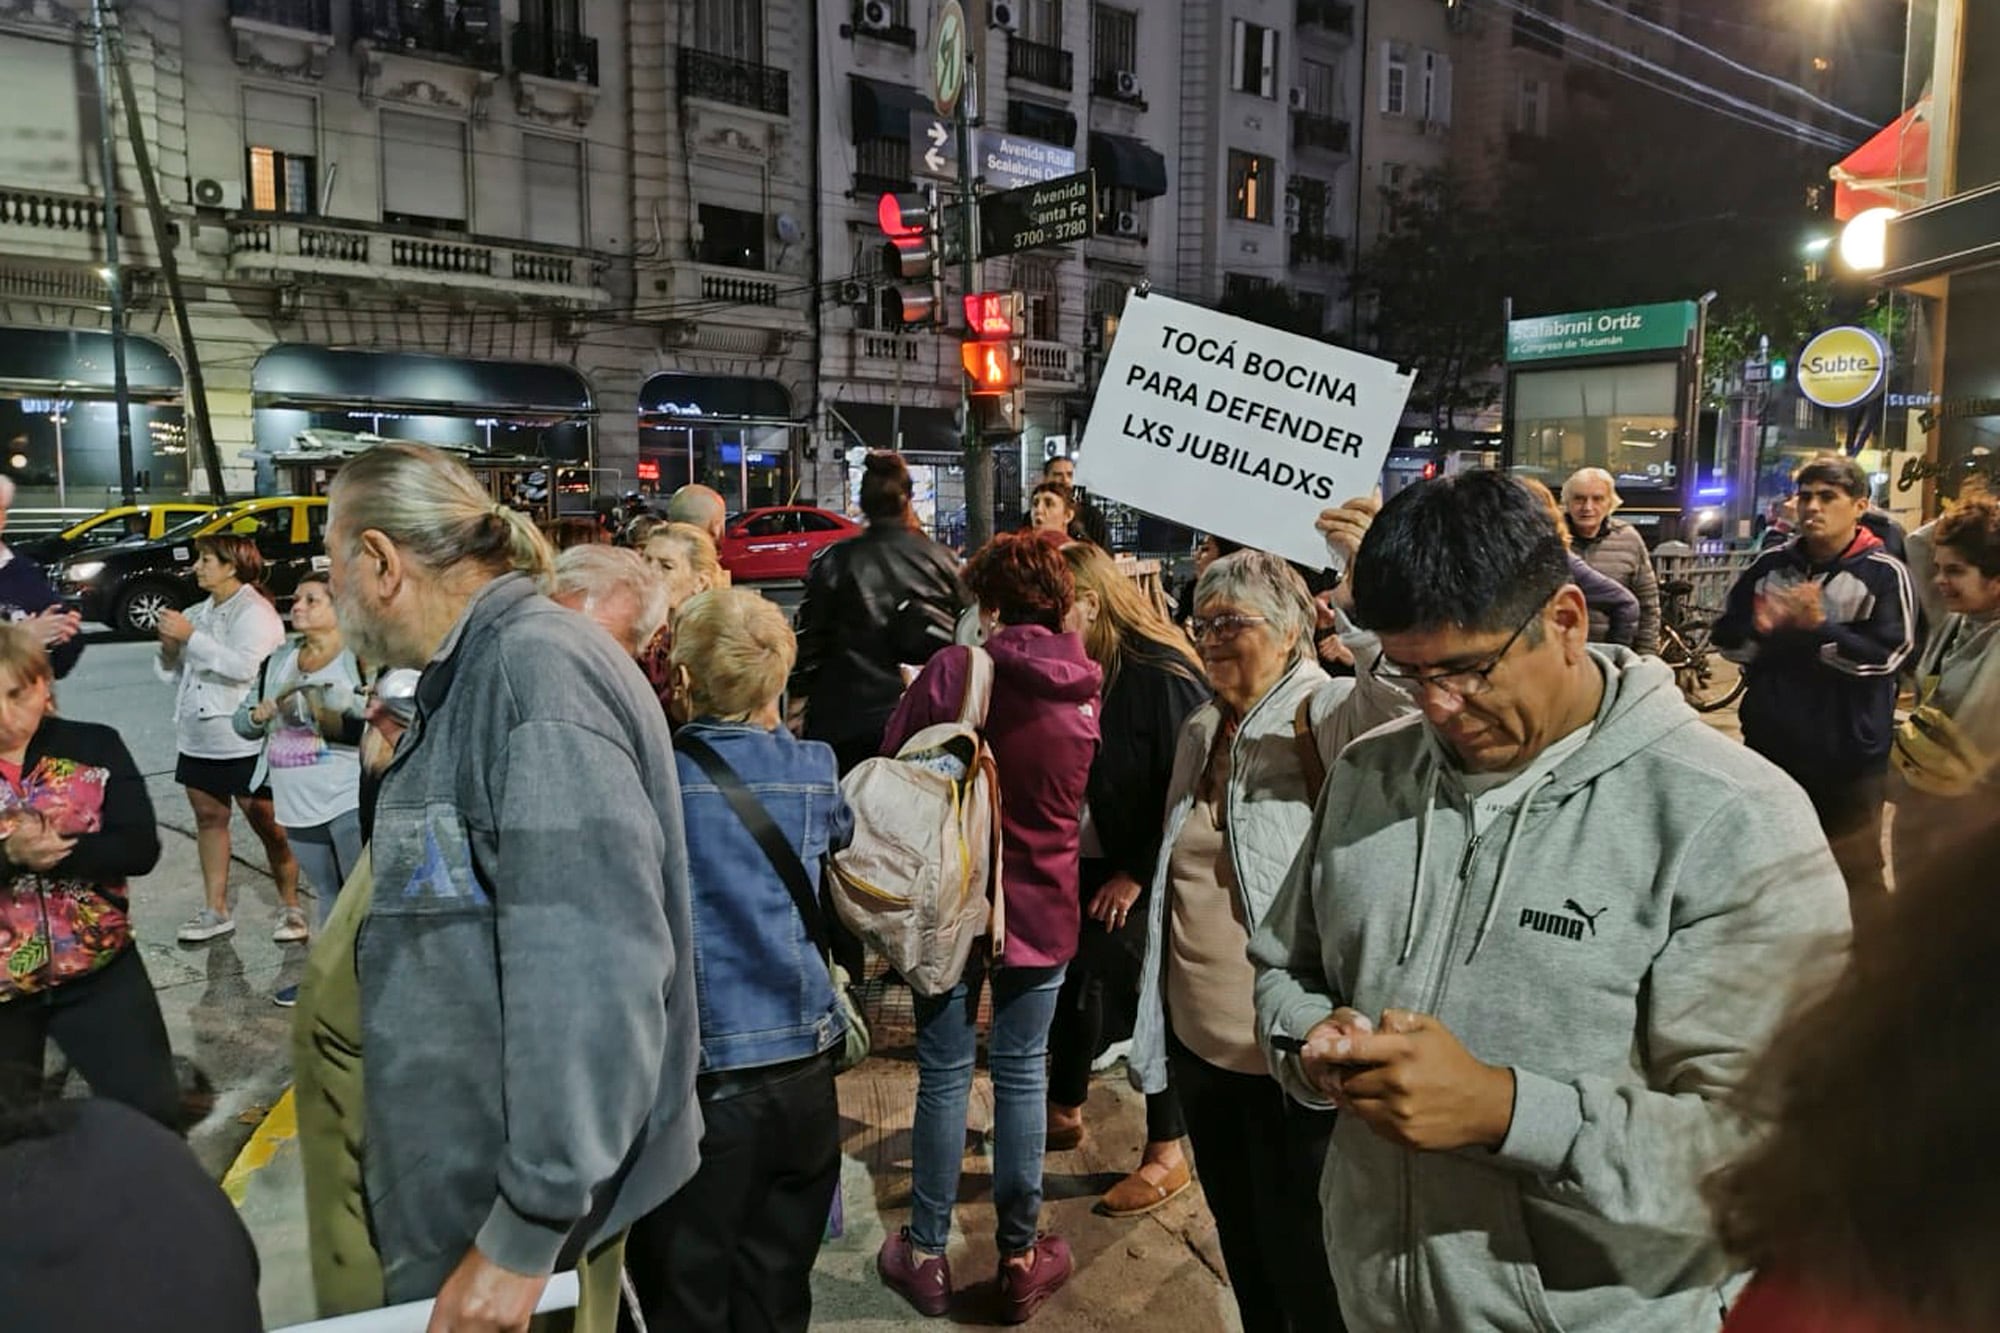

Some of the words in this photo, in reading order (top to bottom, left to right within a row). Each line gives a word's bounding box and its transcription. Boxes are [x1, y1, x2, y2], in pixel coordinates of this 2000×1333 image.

[1000, 139, 1044, 161] Avenida
[1032, 182, 1087, 207] Avenida
[1030, 206, 1067, 226] Santa
[1070, 201, 1086, 218] Fe
[1013, 229, 1044, 248] 3700
[1055, 219, 1087, 240] 3780
[1598, 312, 1643, 332] Ortiz
[1162, 326, 1238, 369] TOCÁ
[1242, 352, 1356, 407] BOCINA
[1810, 356, 1870, 374] Subte
[1126, 365, 1198, 407] PARA
[1206, 390, 1363, 458] DEFENDER
[1122, 414, 1174, 448] LXS
[1176, 432, 1334, 500] JUBILADXS
[1518, 908, 1584, 941] PUMA
